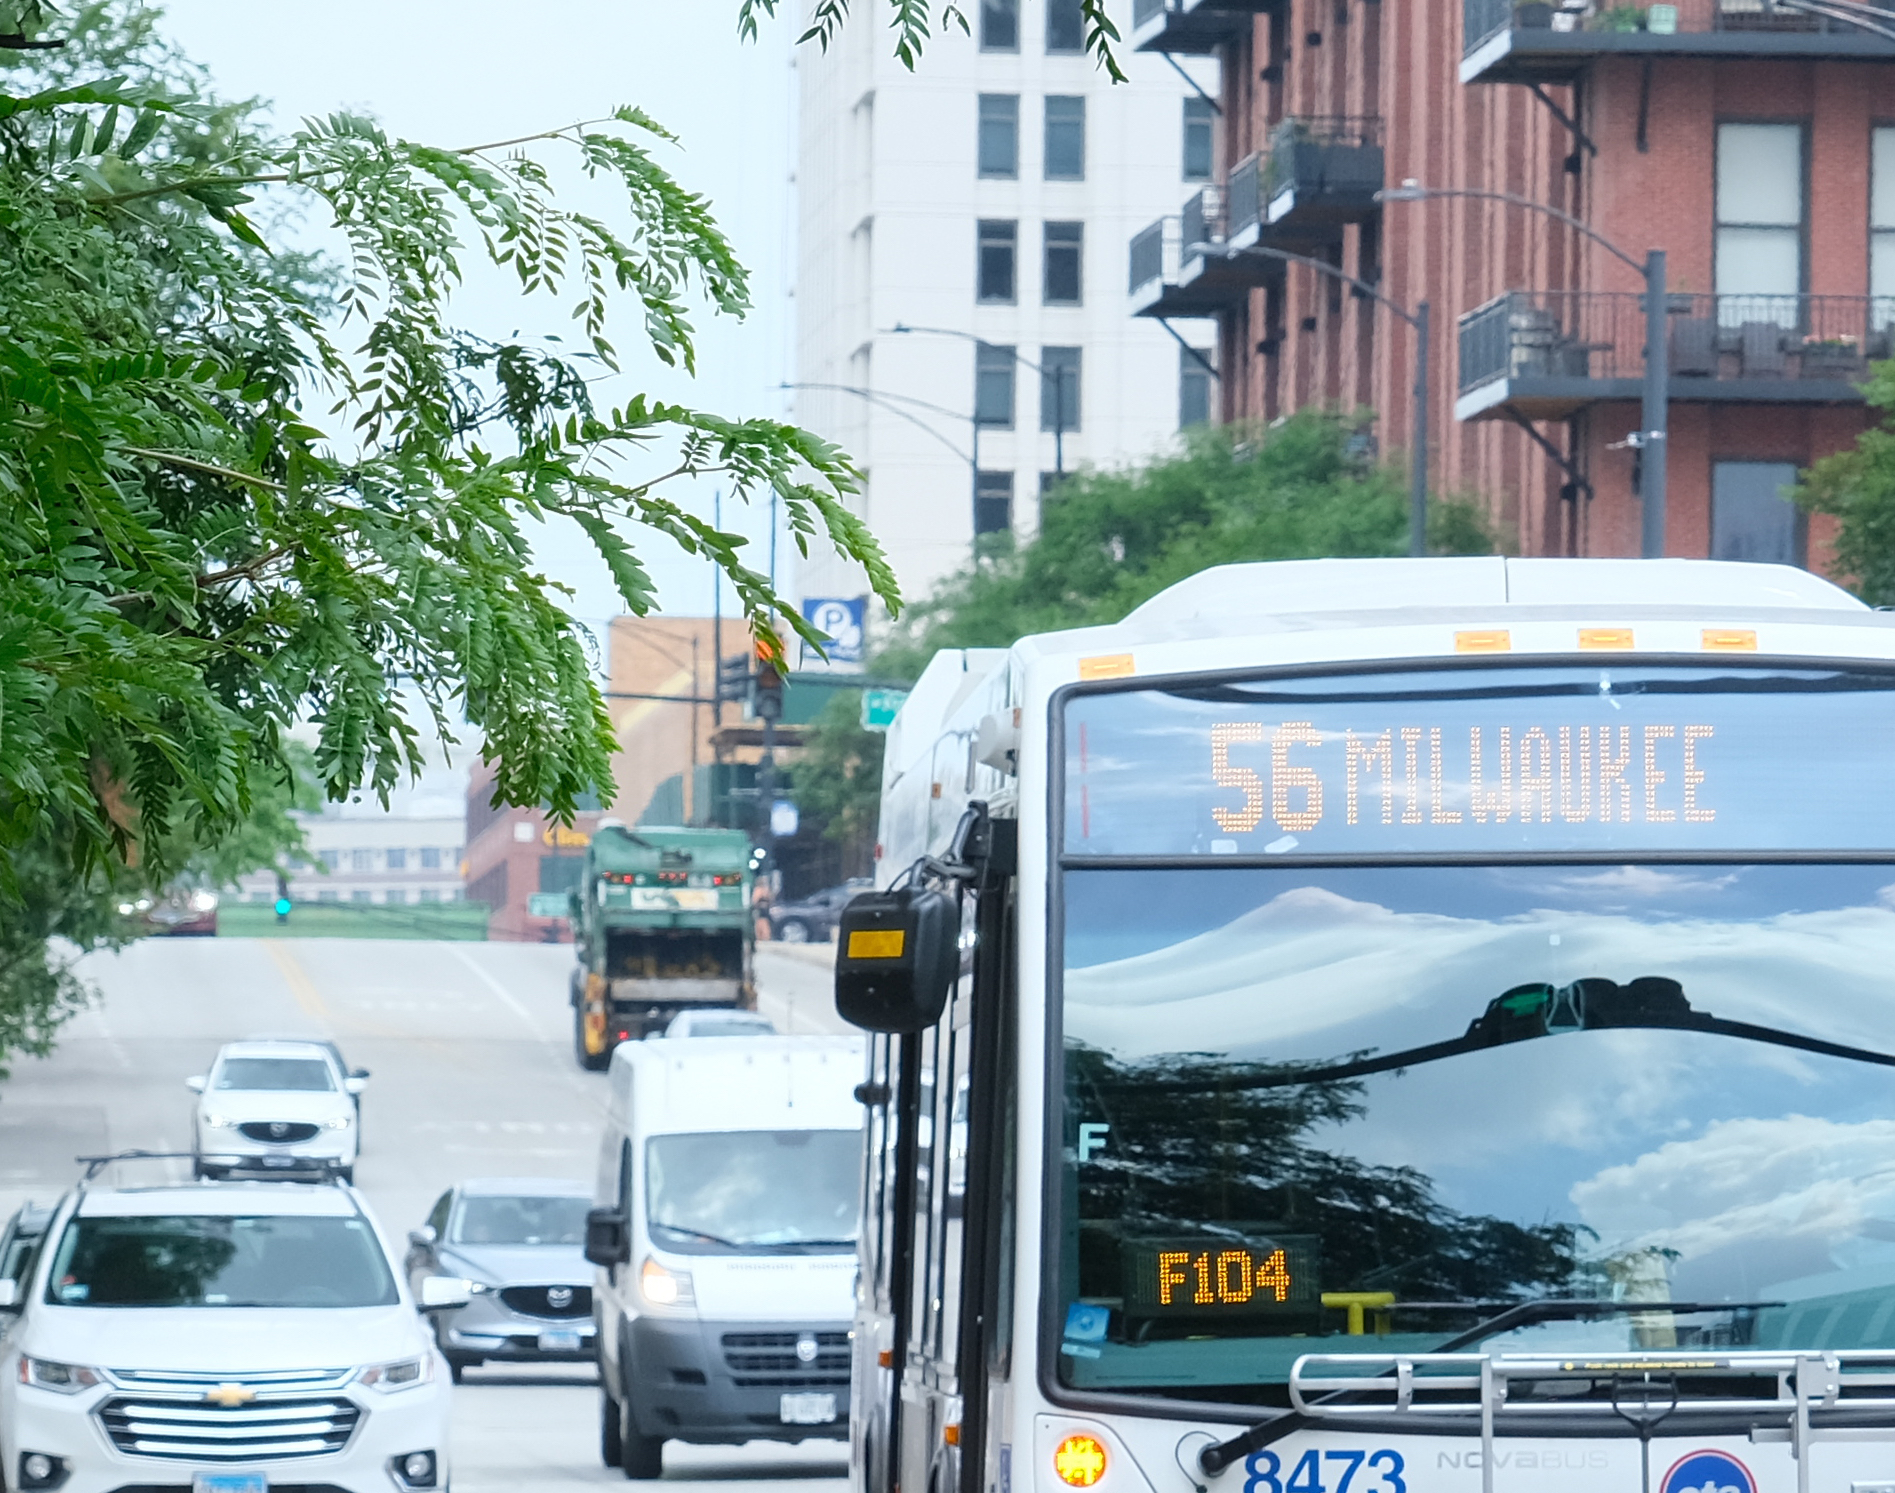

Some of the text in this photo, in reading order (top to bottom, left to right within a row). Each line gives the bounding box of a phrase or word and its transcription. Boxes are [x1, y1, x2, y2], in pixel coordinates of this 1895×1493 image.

[1211, 720, 1716, 833] 56 MILWAUKEE
[1078, 1122, 1110, 1162] F
[1159, 1250, 1291, 1305] F104
